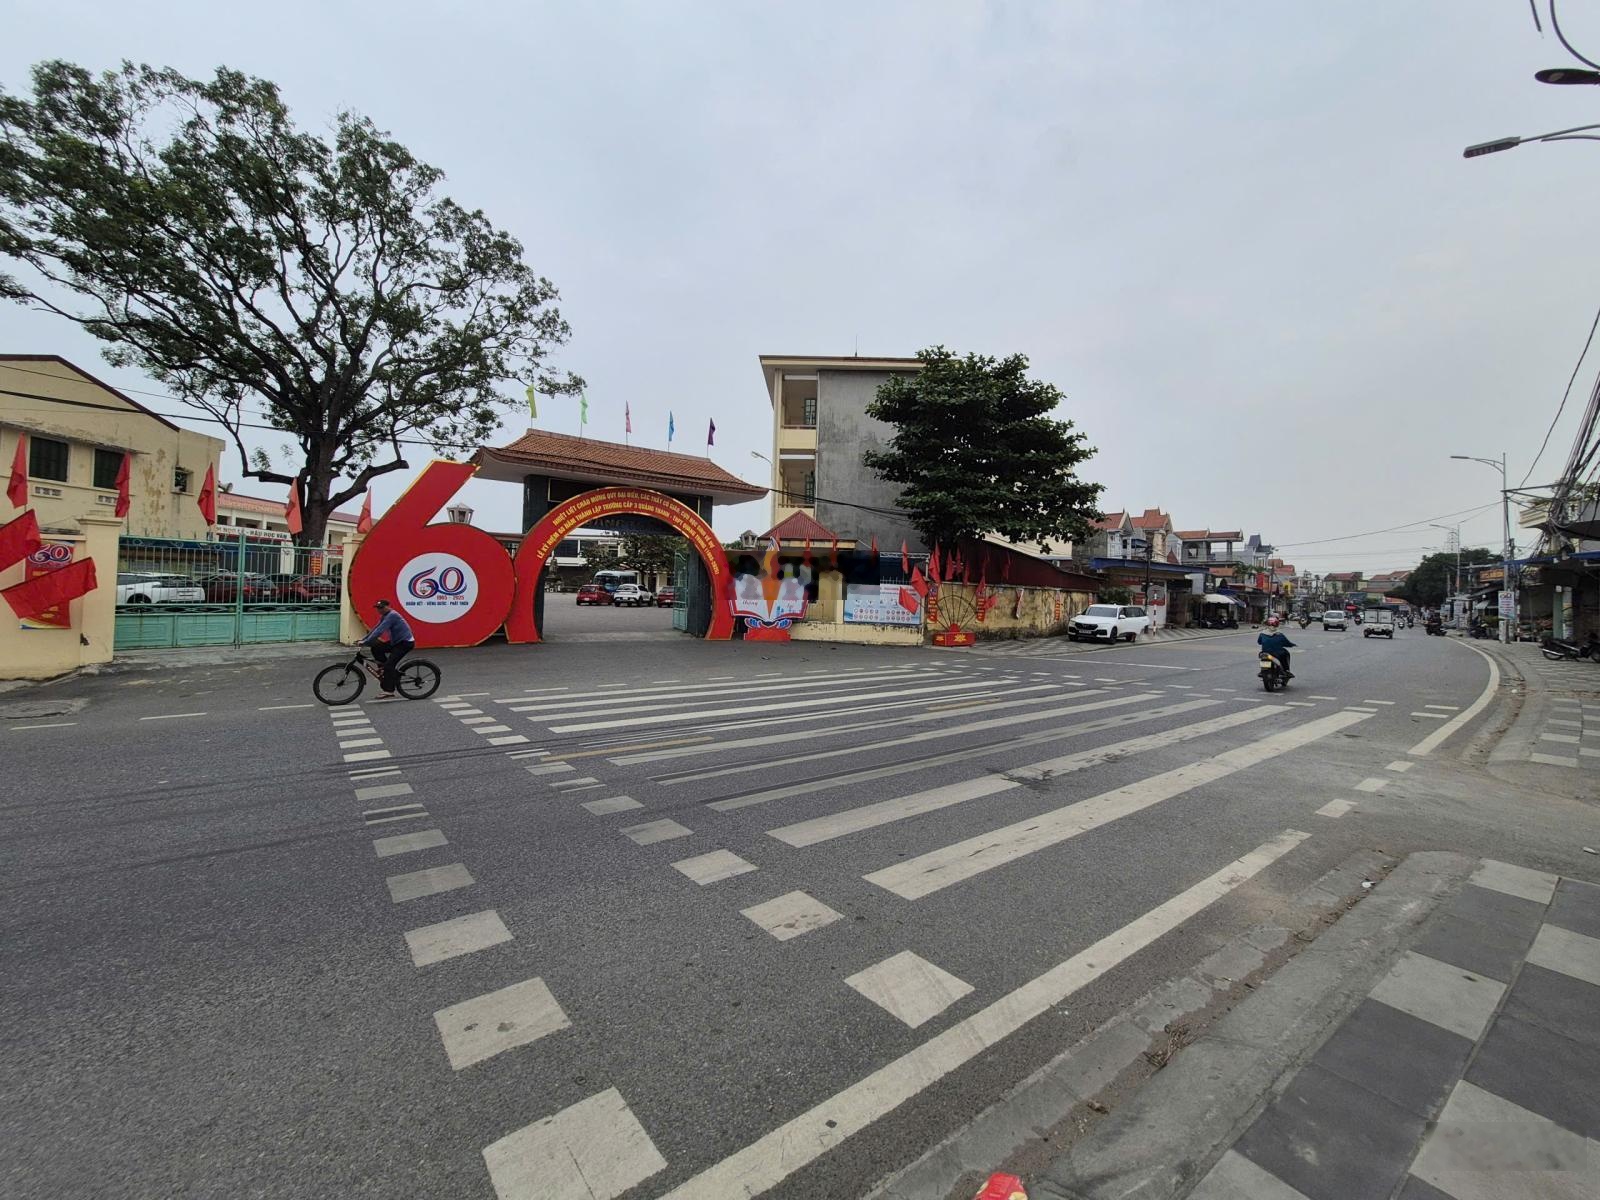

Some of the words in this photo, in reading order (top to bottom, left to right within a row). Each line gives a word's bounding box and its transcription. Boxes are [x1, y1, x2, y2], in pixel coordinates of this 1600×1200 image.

[537, 549, 544, 559] LỄ
[547, 532, 559, 545] NIỆM
[558, 526, 565, 534] 60
[564, 517, 577, 529] NĂM
[576, 510, 593, 521] THÀNH
[592, 505, 601, 514] LẬP
[603, 501, 622, 510] TRƯỜNG
[673, 516, 684, 525] THPT
[553, 512, 567, 526] NHIỆT
[566, 506, 577, 516] LIỆT
[577, 498, 591, 509] CHÀO
[591, 494, 606, 502] MỪNG
[697, 525, 706, 536] SINH
[408, 566, 467, 599] 60
